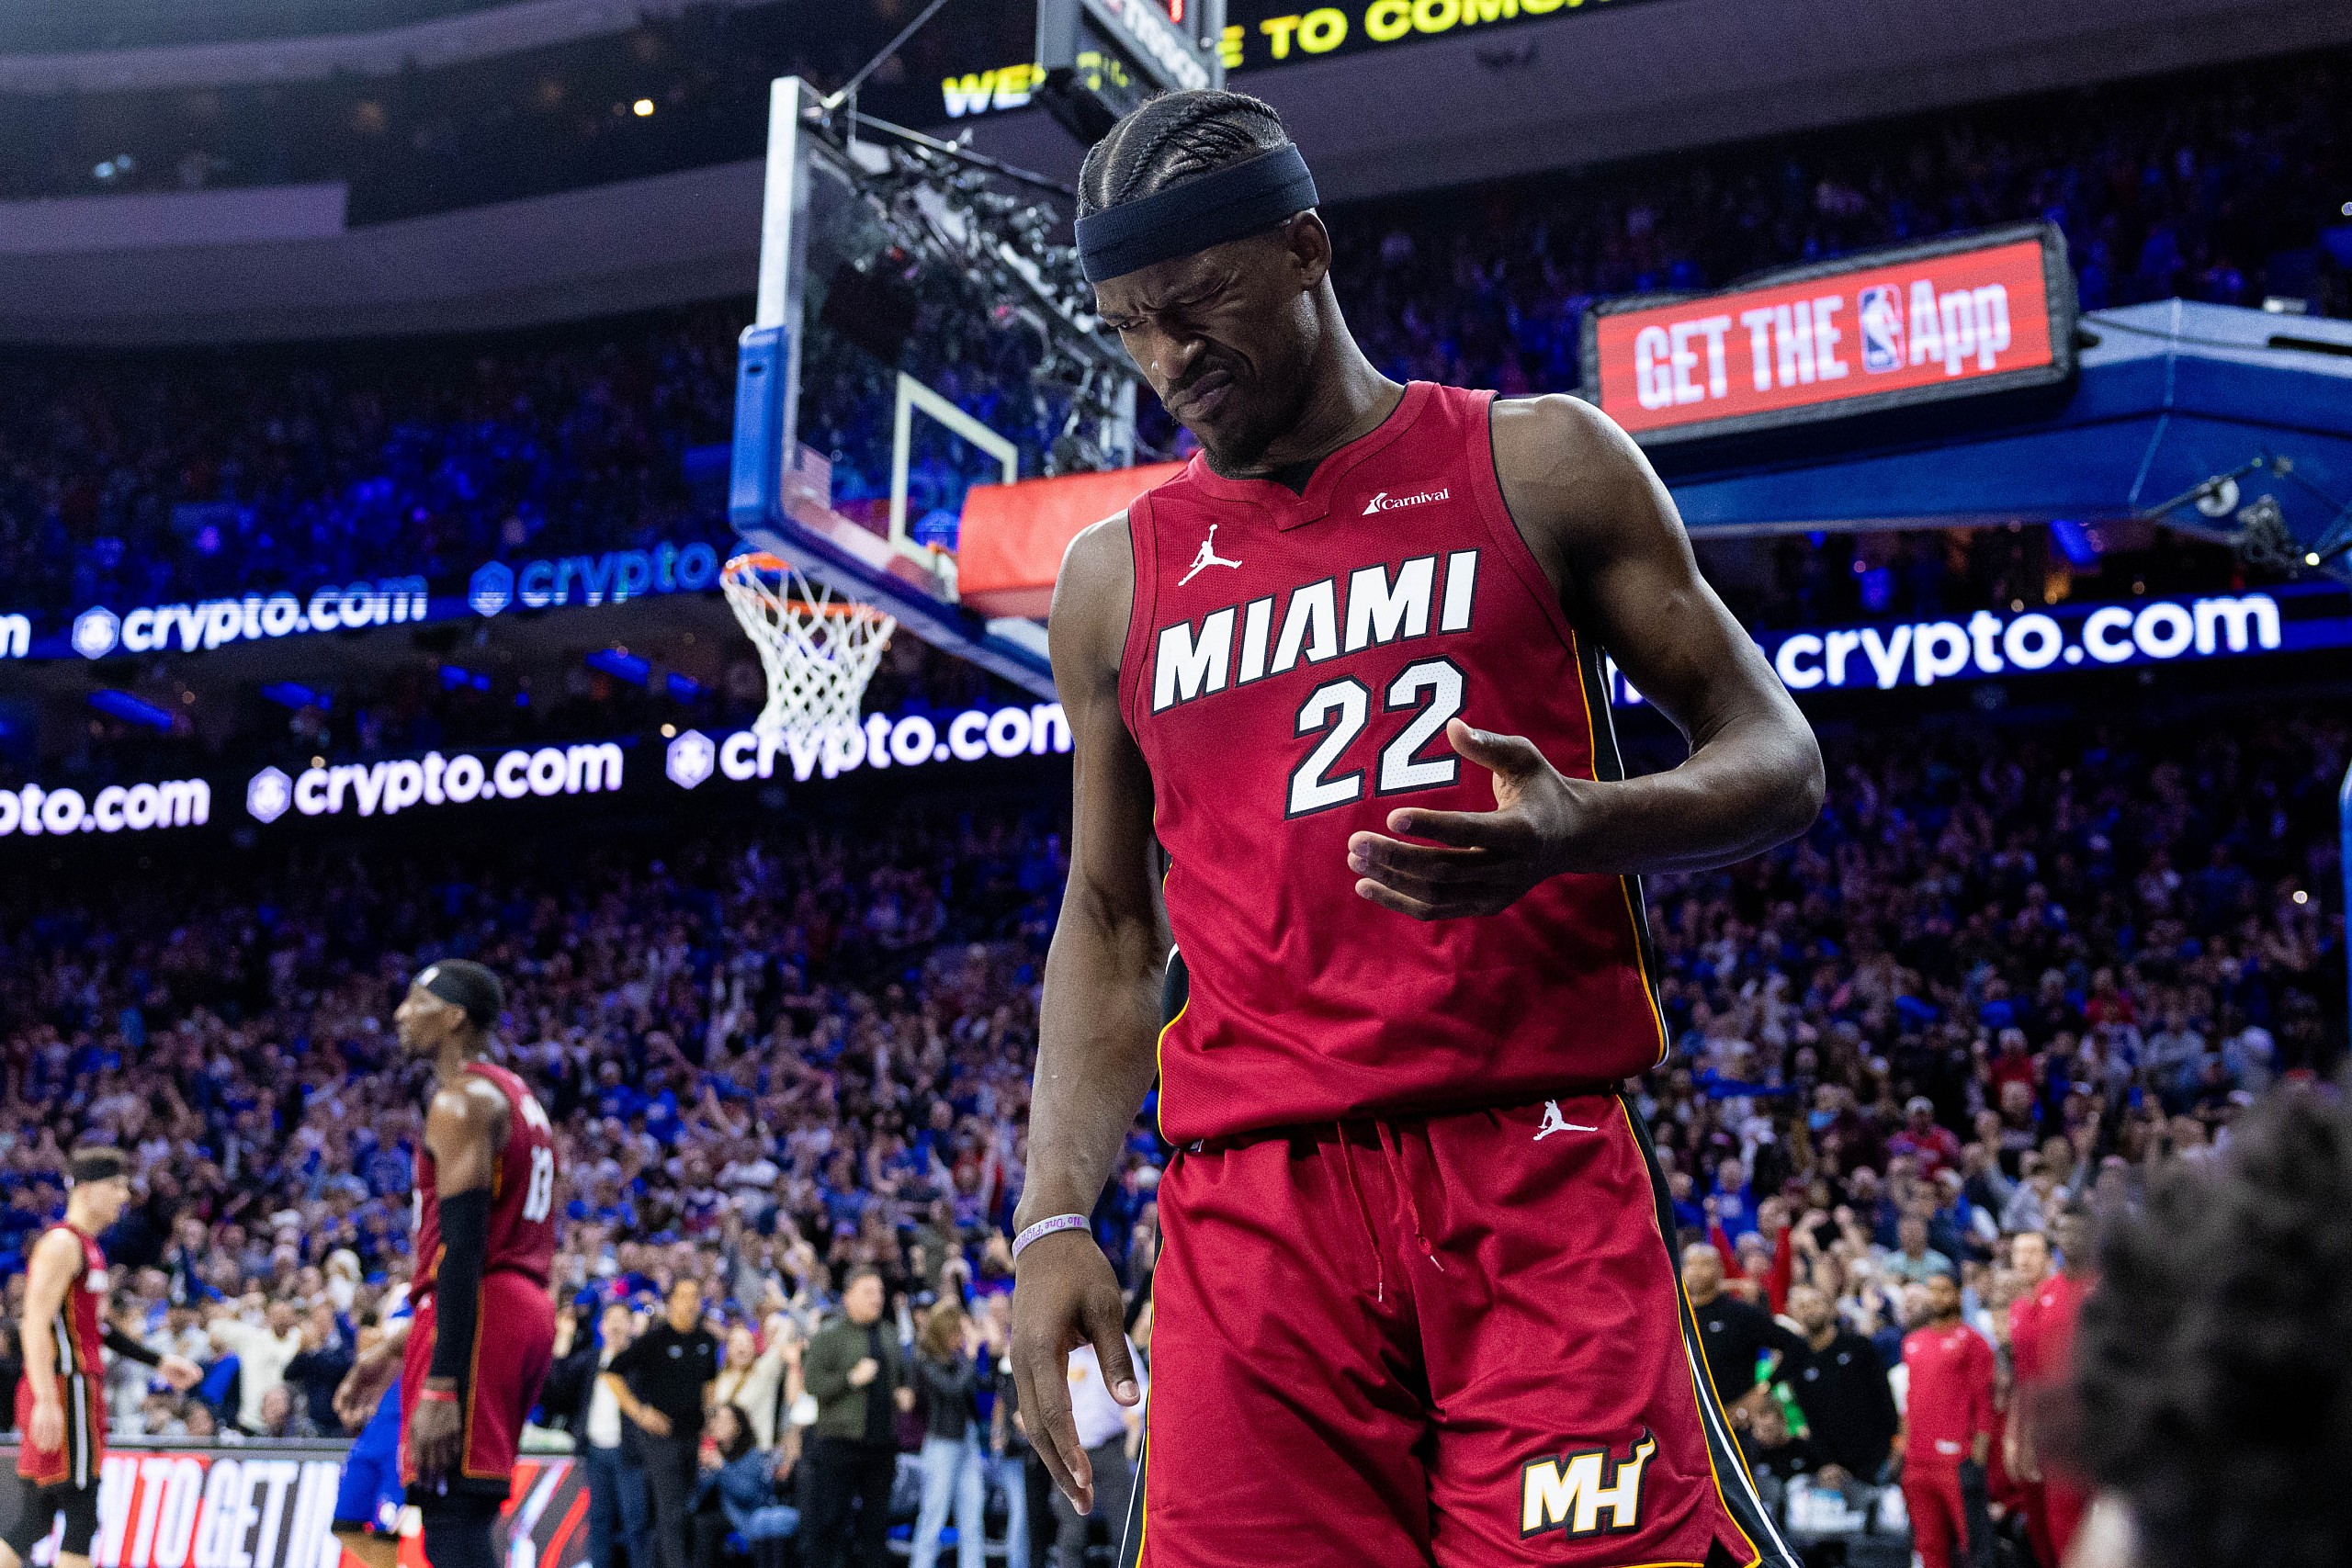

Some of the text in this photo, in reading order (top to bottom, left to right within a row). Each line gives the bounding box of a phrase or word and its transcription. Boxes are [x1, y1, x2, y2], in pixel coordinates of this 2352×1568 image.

[1259, 7, 1349, 60] TO
[1634, 278, 2012, 411] GET THE App
[1381, 488, 1450, 510] Carnival
[121, 575, 428, 652] crypto.com
[1150, 547, 1481, 716] MIAMI
[1775, 592, 2282, 691] crypto.com
[294, 742, 624, 816] crypto.com
[1283, 654, 1468, 820] 22
[193, 1458, 300, 1568] GET
